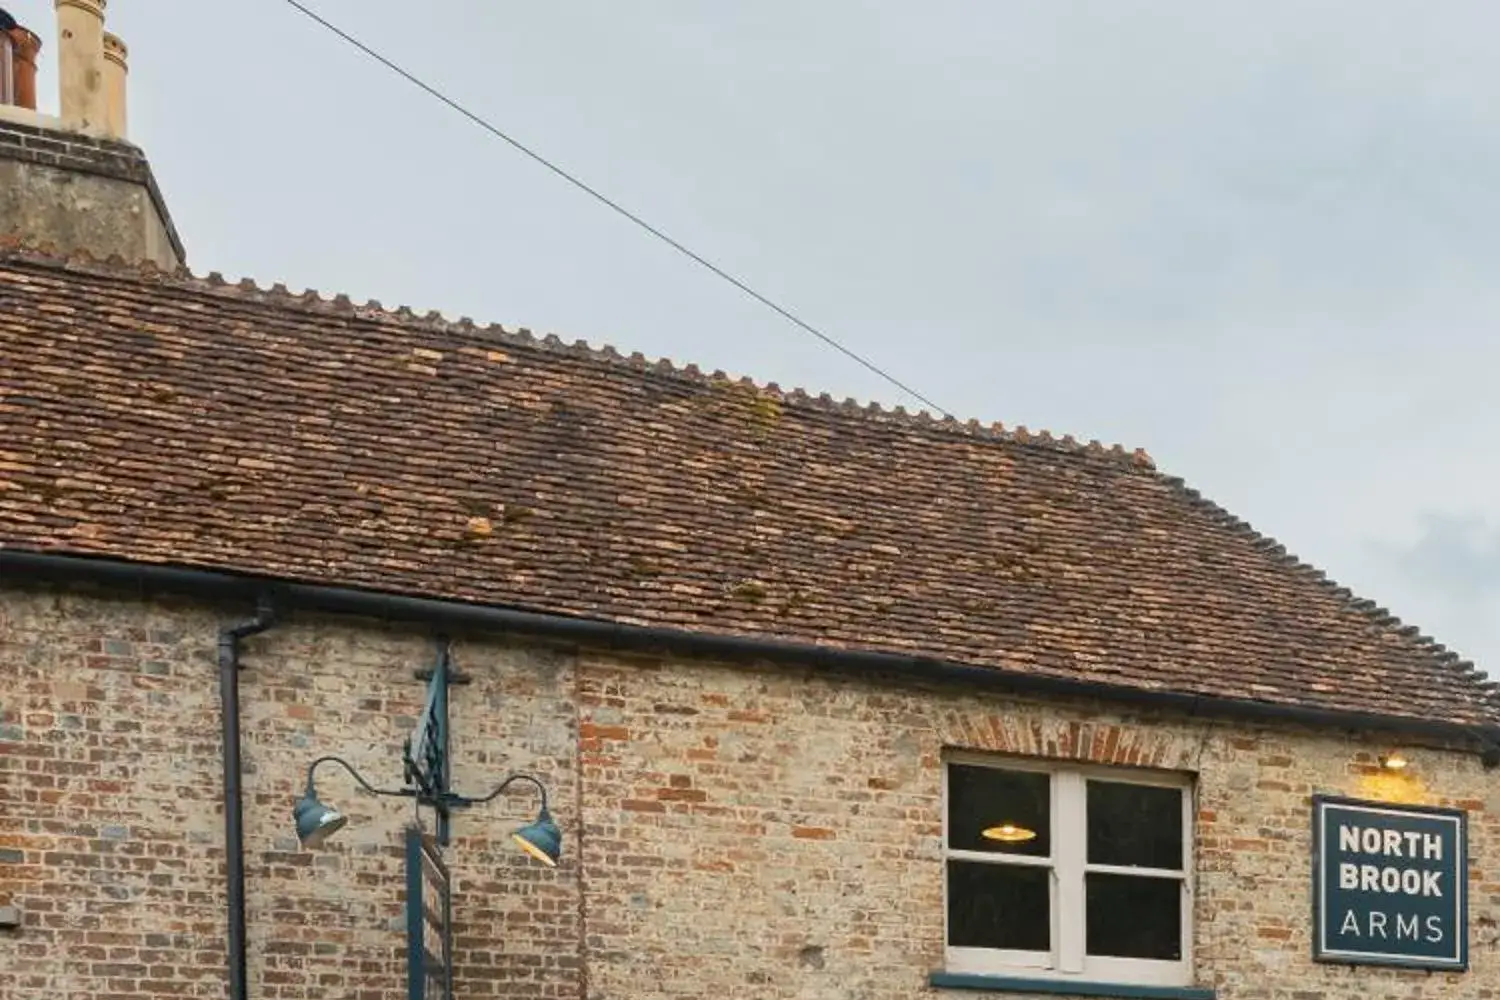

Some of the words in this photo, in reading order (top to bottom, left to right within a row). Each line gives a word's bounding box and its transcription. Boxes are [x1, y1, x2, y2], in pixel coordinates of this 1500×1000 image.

[1340, 825, 1442, 860] NORTH
[1340, 863, 1443, 897] BROOK
[1341, 909, 1443, 942] ARMS
